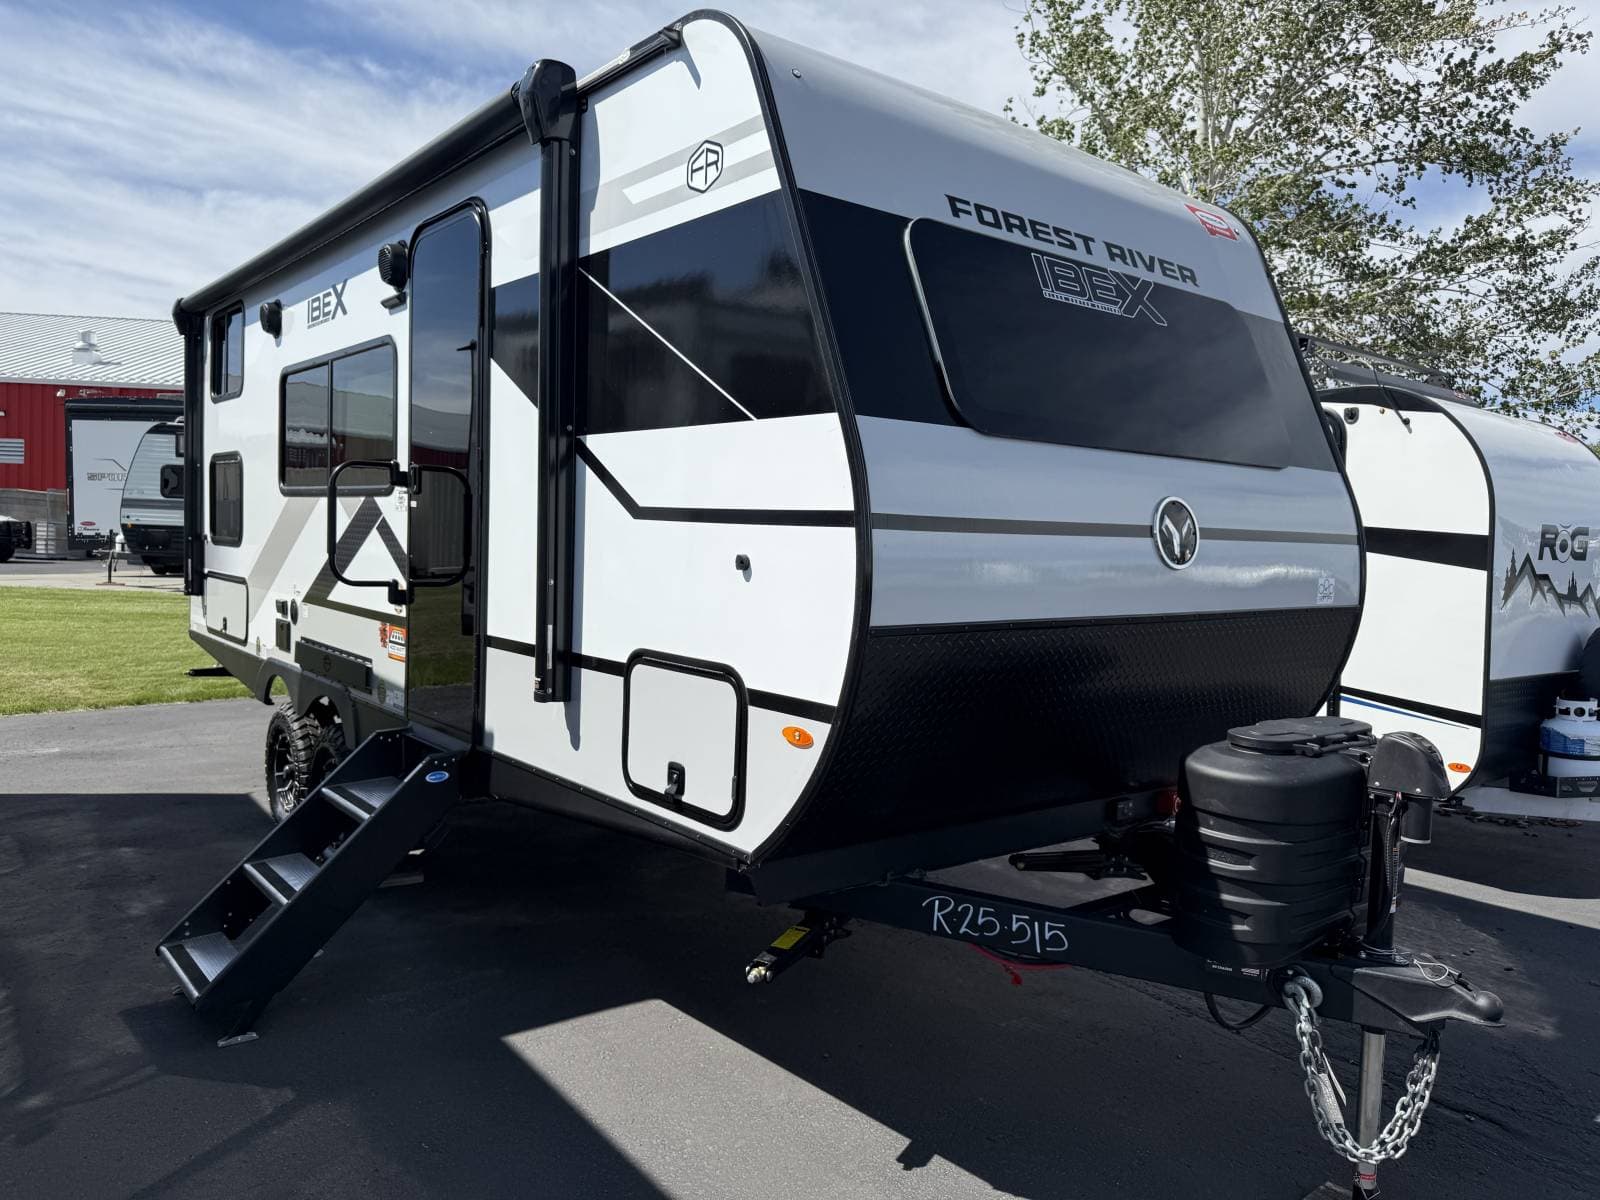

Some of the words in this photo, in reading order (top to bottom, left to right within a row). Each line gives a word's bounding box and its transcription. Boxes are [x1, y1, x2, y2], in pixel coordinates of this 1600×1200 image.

[944, 193, 1095, 256] FOREST
[1102, 240, 1200, 288] RIVER
[307, 277, 348, 325] IBEX
[1031, 252, 1168, 327] IBEX
